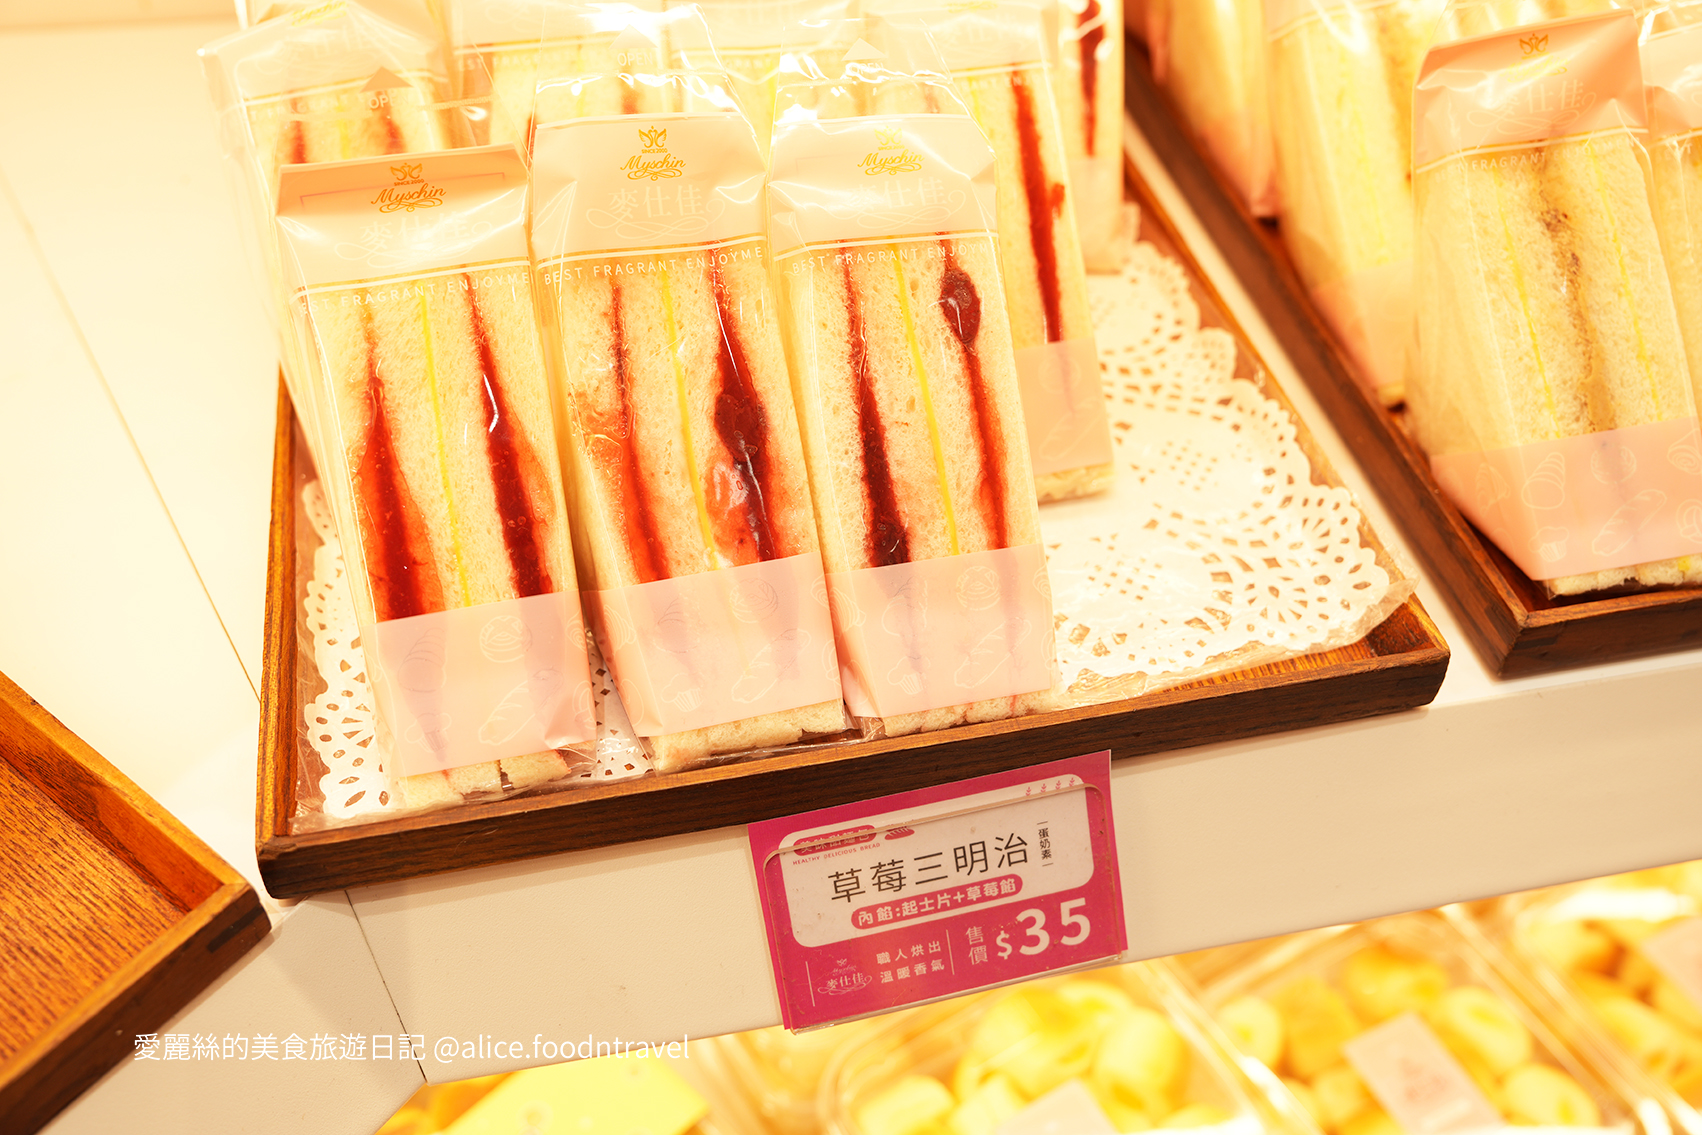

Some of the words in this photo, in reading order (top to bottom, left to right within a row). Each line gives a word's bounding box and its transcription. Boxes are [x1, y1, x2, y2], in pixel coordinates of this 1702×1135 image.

[617, 52, 654, 67] OPEN
[620, 153, 686, 181] Myschin
[857, 148, 925, 176] Myschin
[1472, 152, 1547, 171] FRAGRANT
[370, 182, 447, 212] Myschin
[608, 184, 705, 219] 麥仕佳
[544, 267, 583, 285] BEST
[593, 259, 677, 277] FRAGRANT
[792, 256, 826, 274] BEST
[835, 248, 918, 266] FRAGRANT
[341, 283, 437, 307] FRAGRANT
[792, 855, 821, 866] HEALTHY
[823, 847, 858, 860] DELICIOUS
[859, 842, 881, 852] BREAD
[1038, 827, 1052, 860] 蛋奶素
[828, 832, 1028, 903] 草莓三明治
[995, 897, 1091, 960] $35
[876, 941, 942, 965] 職人烘出
[965, 926, 989, 966] 售價
[880, 959, 945, 984] 溫暖香氣
